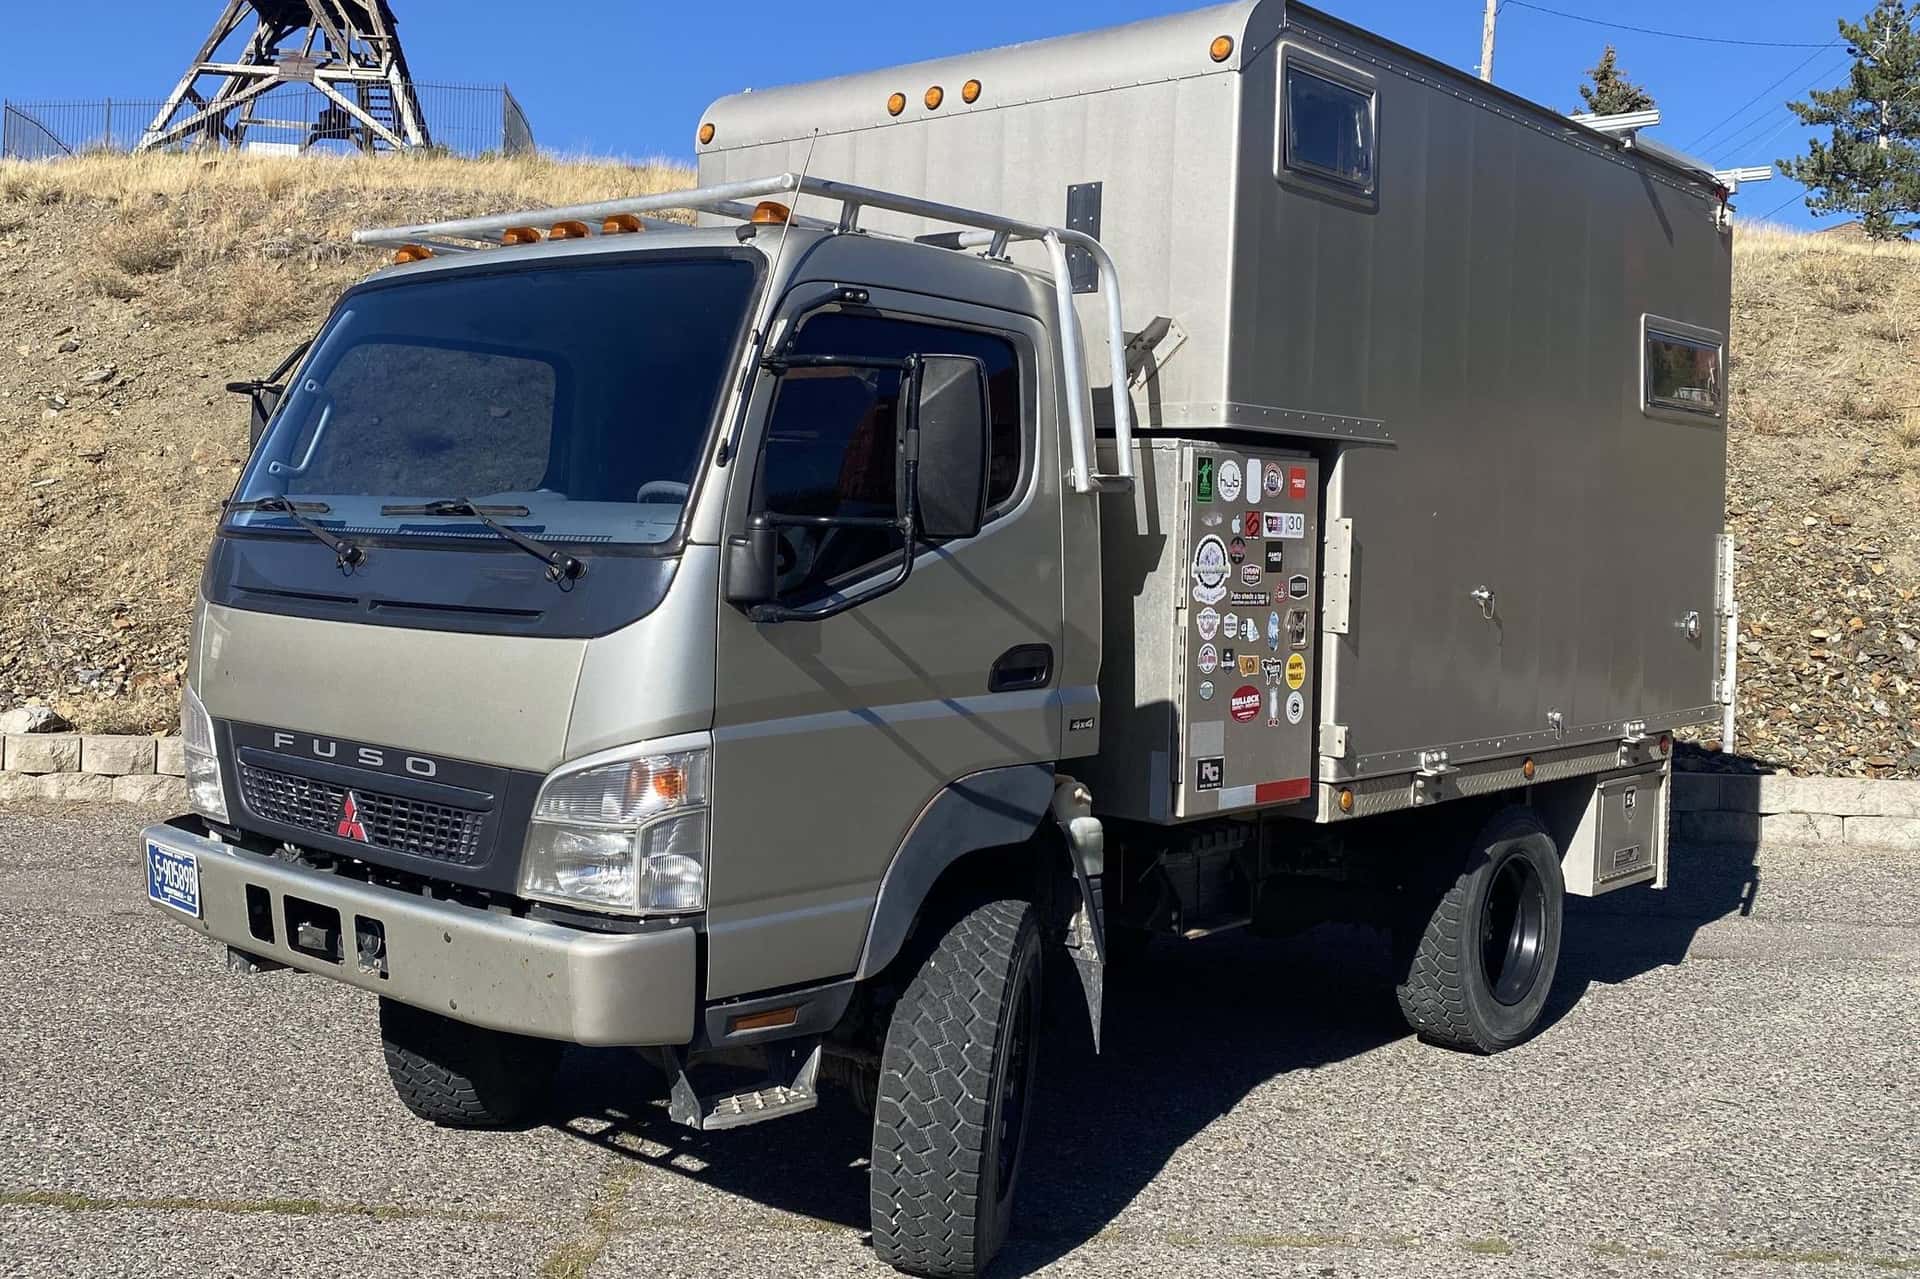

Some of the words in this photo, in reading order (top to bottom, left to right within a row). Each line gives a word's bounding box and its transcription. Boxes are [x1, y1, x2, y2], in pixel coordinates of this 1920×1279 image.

[1220, 471, 1240, 488] hub
[1288, 516, 1302, 530] 30
[1244, 567, 1259, 575] DARN
[1231, 694, 1260, 707] BULLOCK
[1072, 719, 1093, 729] 4x4
[274, 733, 436, 777] FUSO
